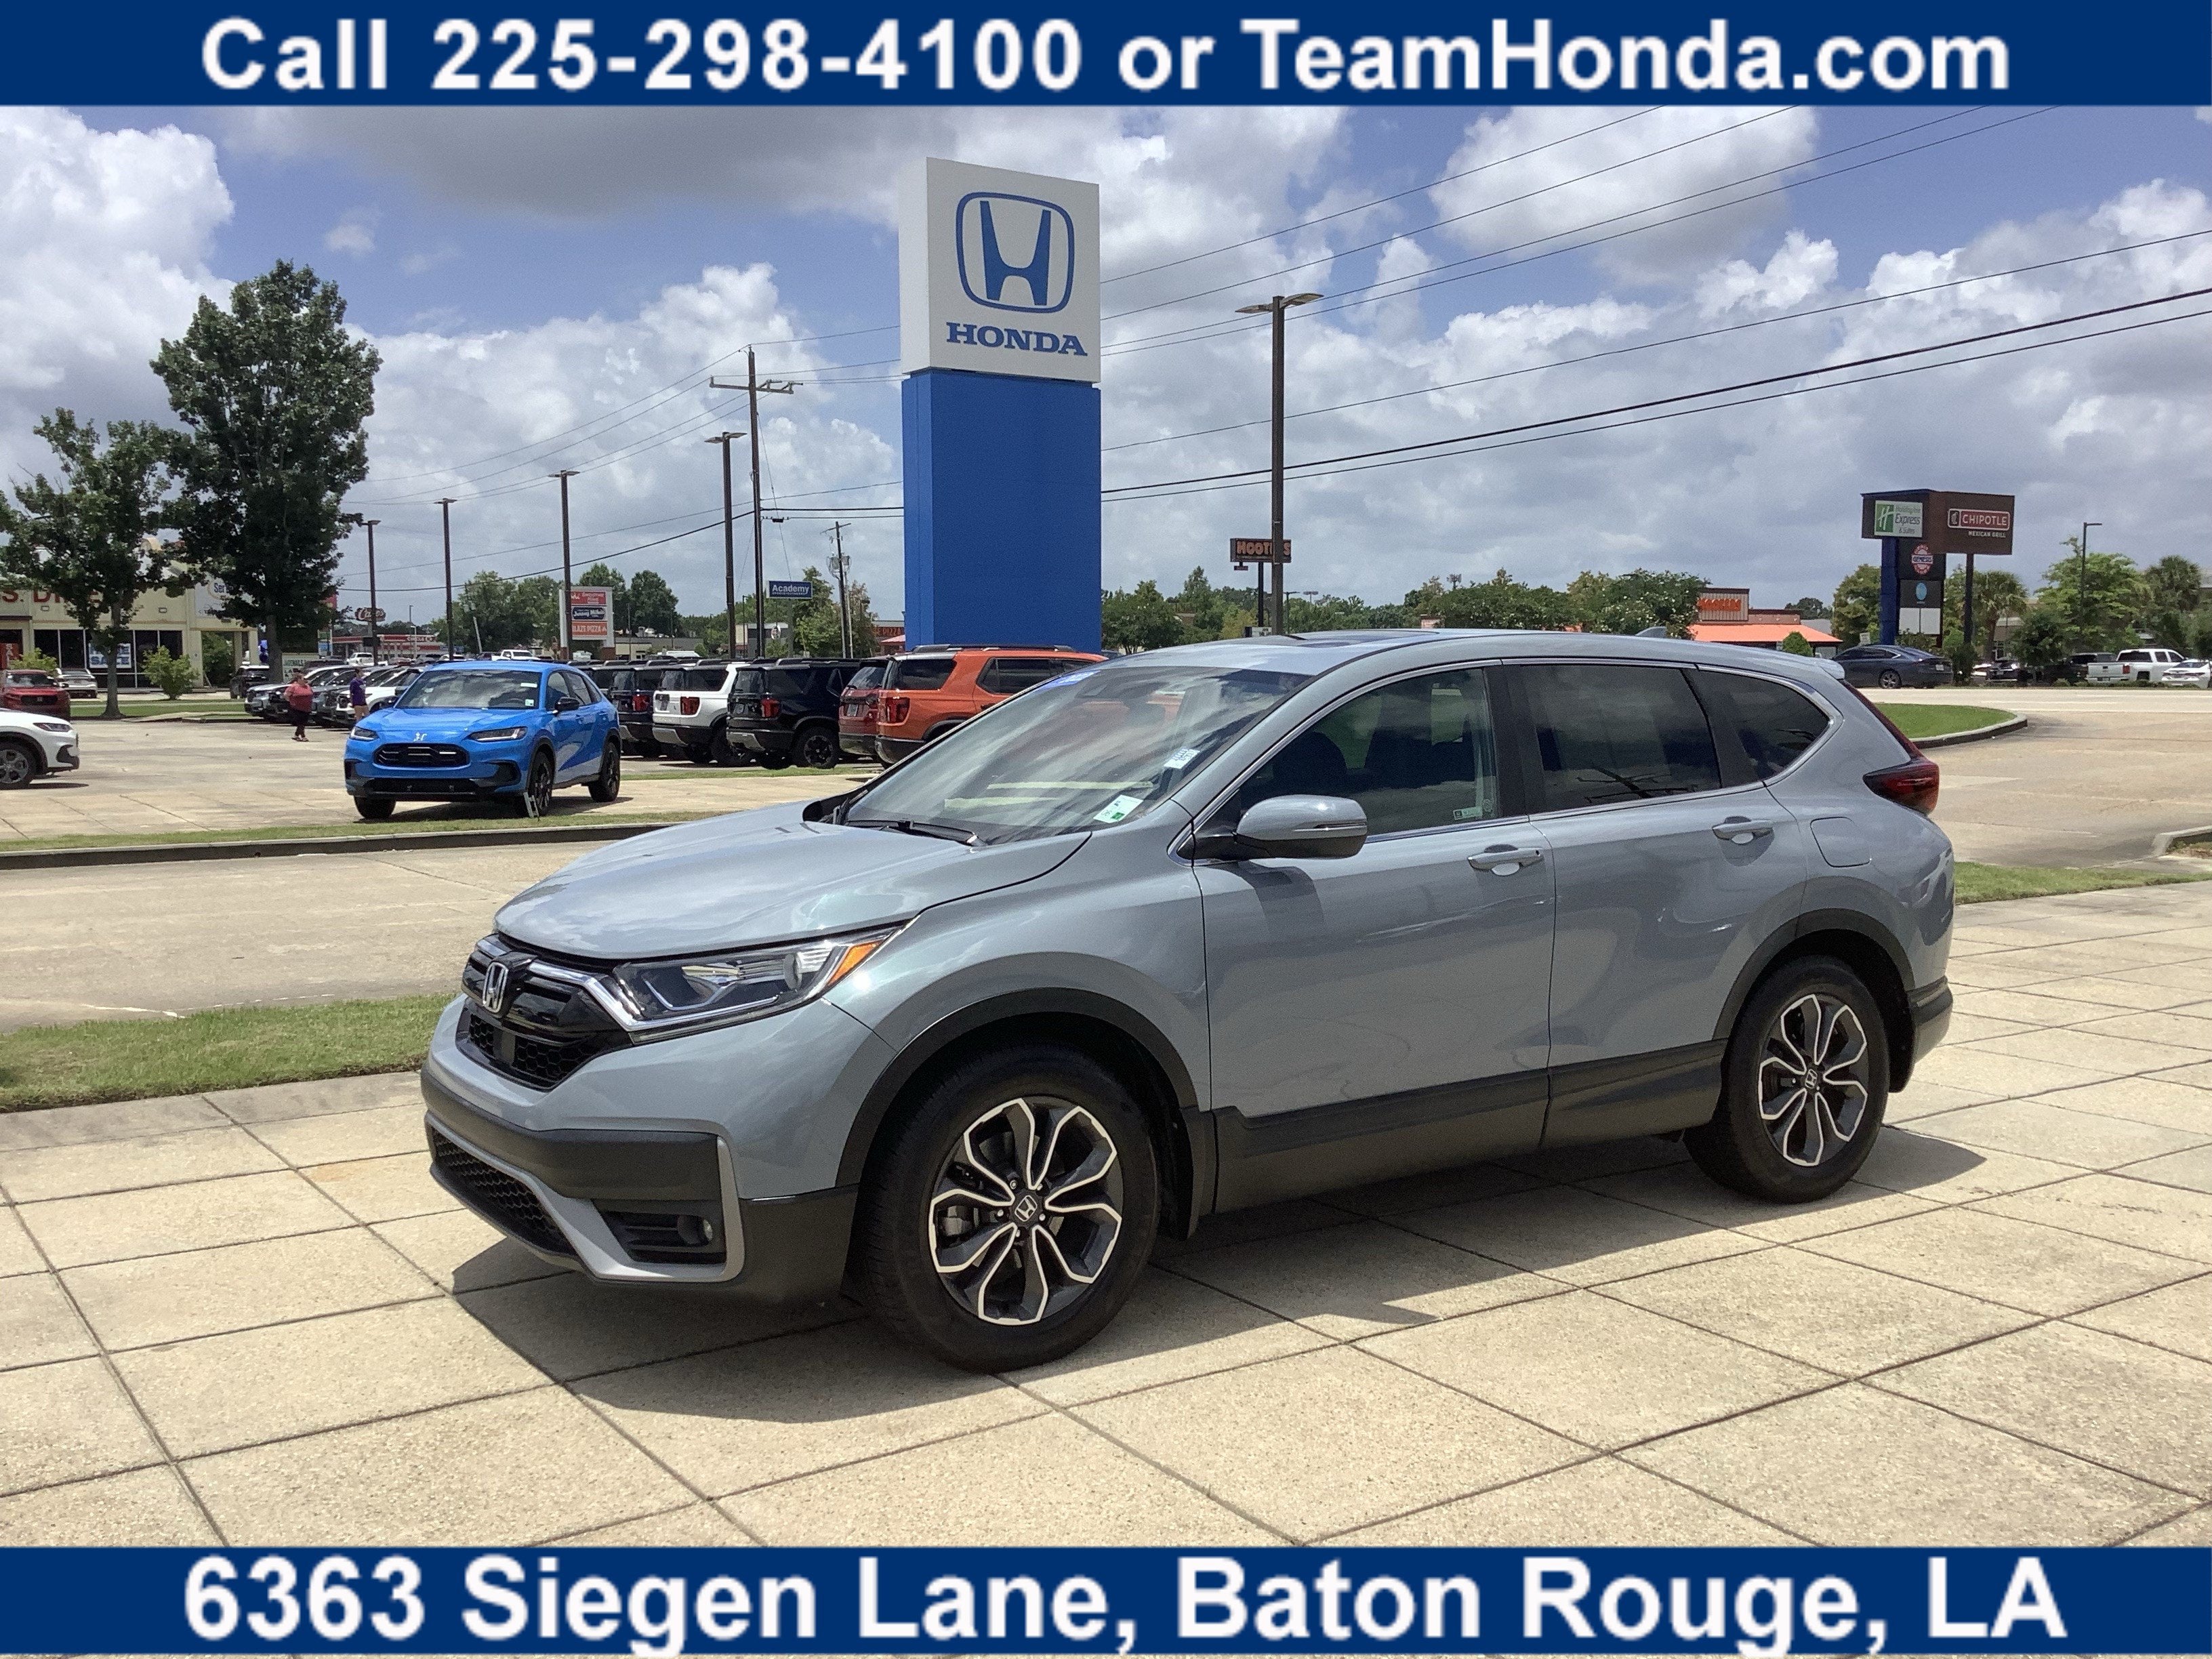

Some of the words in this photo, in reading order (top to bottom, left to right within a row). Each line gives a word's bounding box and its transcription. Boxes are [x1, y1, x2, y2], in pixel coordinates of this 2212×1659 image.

[946, 321, 1088, 357] HONDA
[1895, 513, 1921, 526] Express
[1962, 514, 2008, 527] CHIPOTLE
[1237, 541, 1291, 556] HOOTS
[772, 584, 810, 595] Academy
